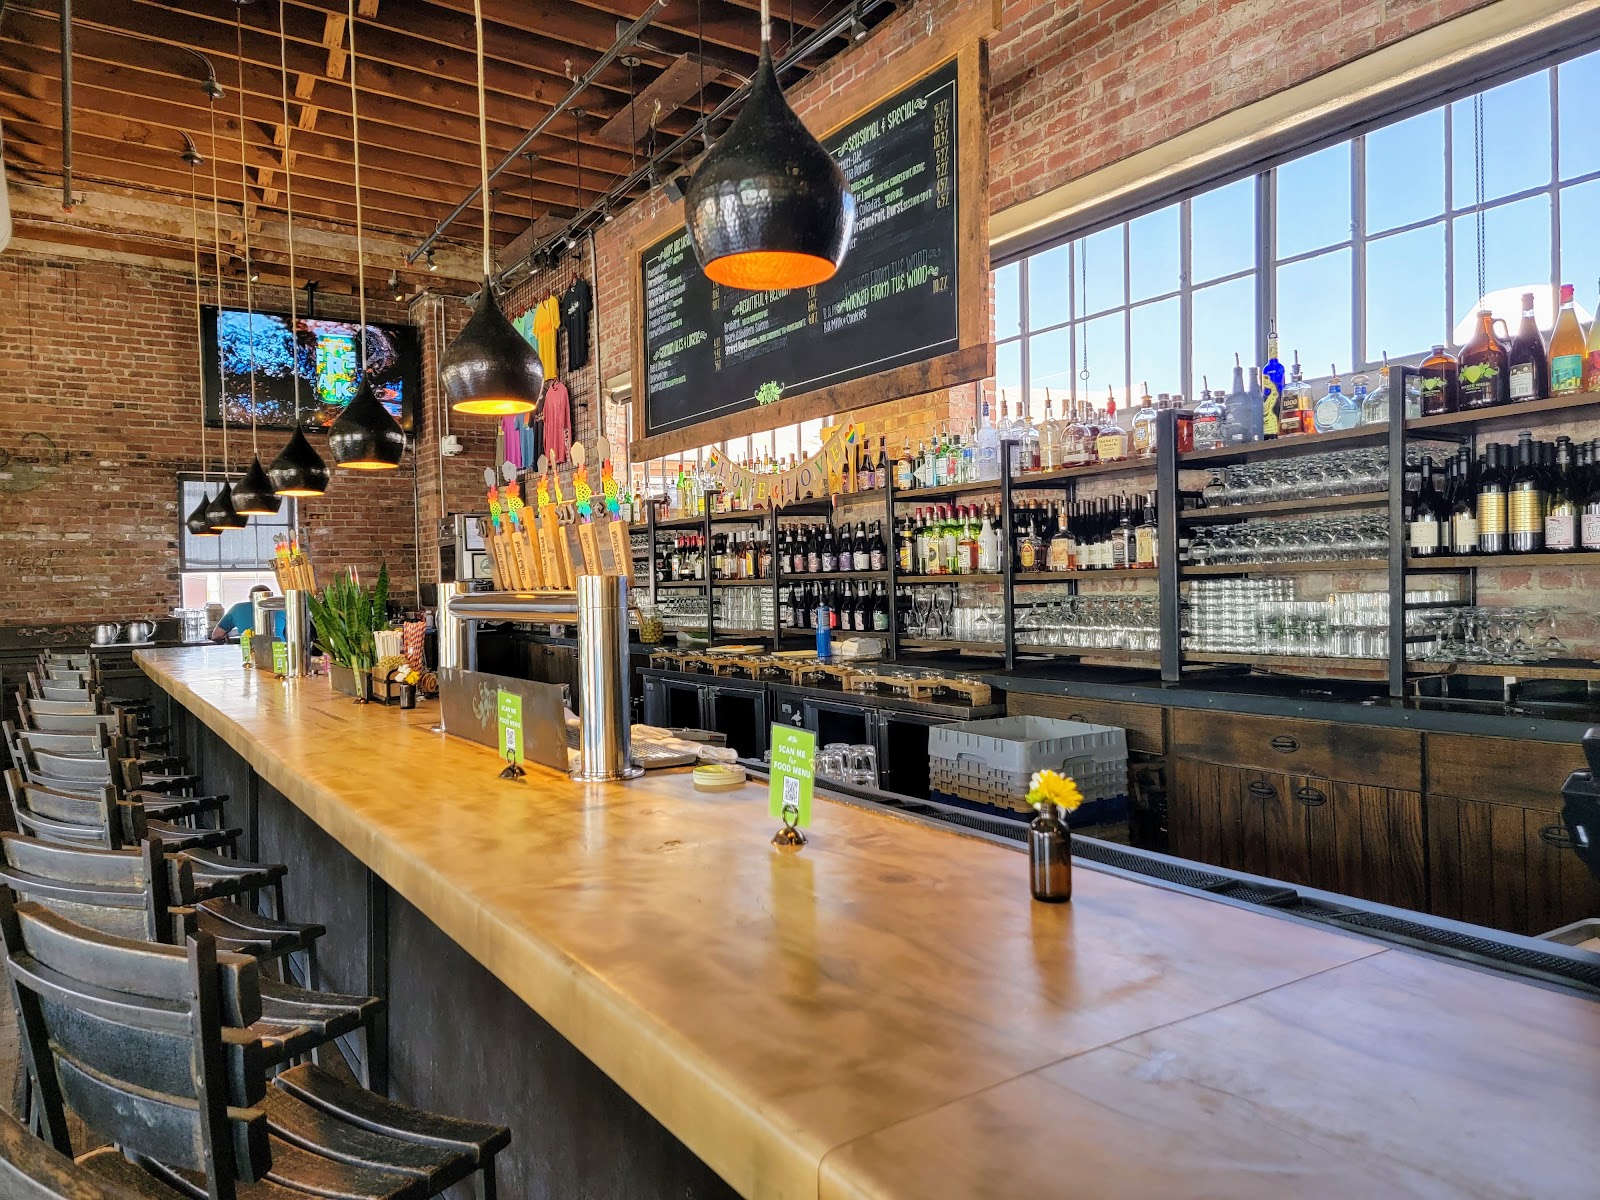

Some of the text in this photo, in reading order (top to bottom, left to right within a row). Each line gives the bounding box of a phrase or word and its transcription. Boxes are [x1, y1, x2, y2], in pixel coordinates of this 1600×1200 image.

[887, 99, 917, 130] SPECIAL
[870, 280, 890, 303] FROM
[891, 273, 906, 295] THE
[906, 264, 928, 289] WOOD
[1283, 399, 1298, 407] 1800
[500, 716, 520, 728] FOOD MENU
[778, 744, 806, 759] SCAN ME
[788, 755, 797, 765] for
[773, 760, 811, 779] FOOD MENU
